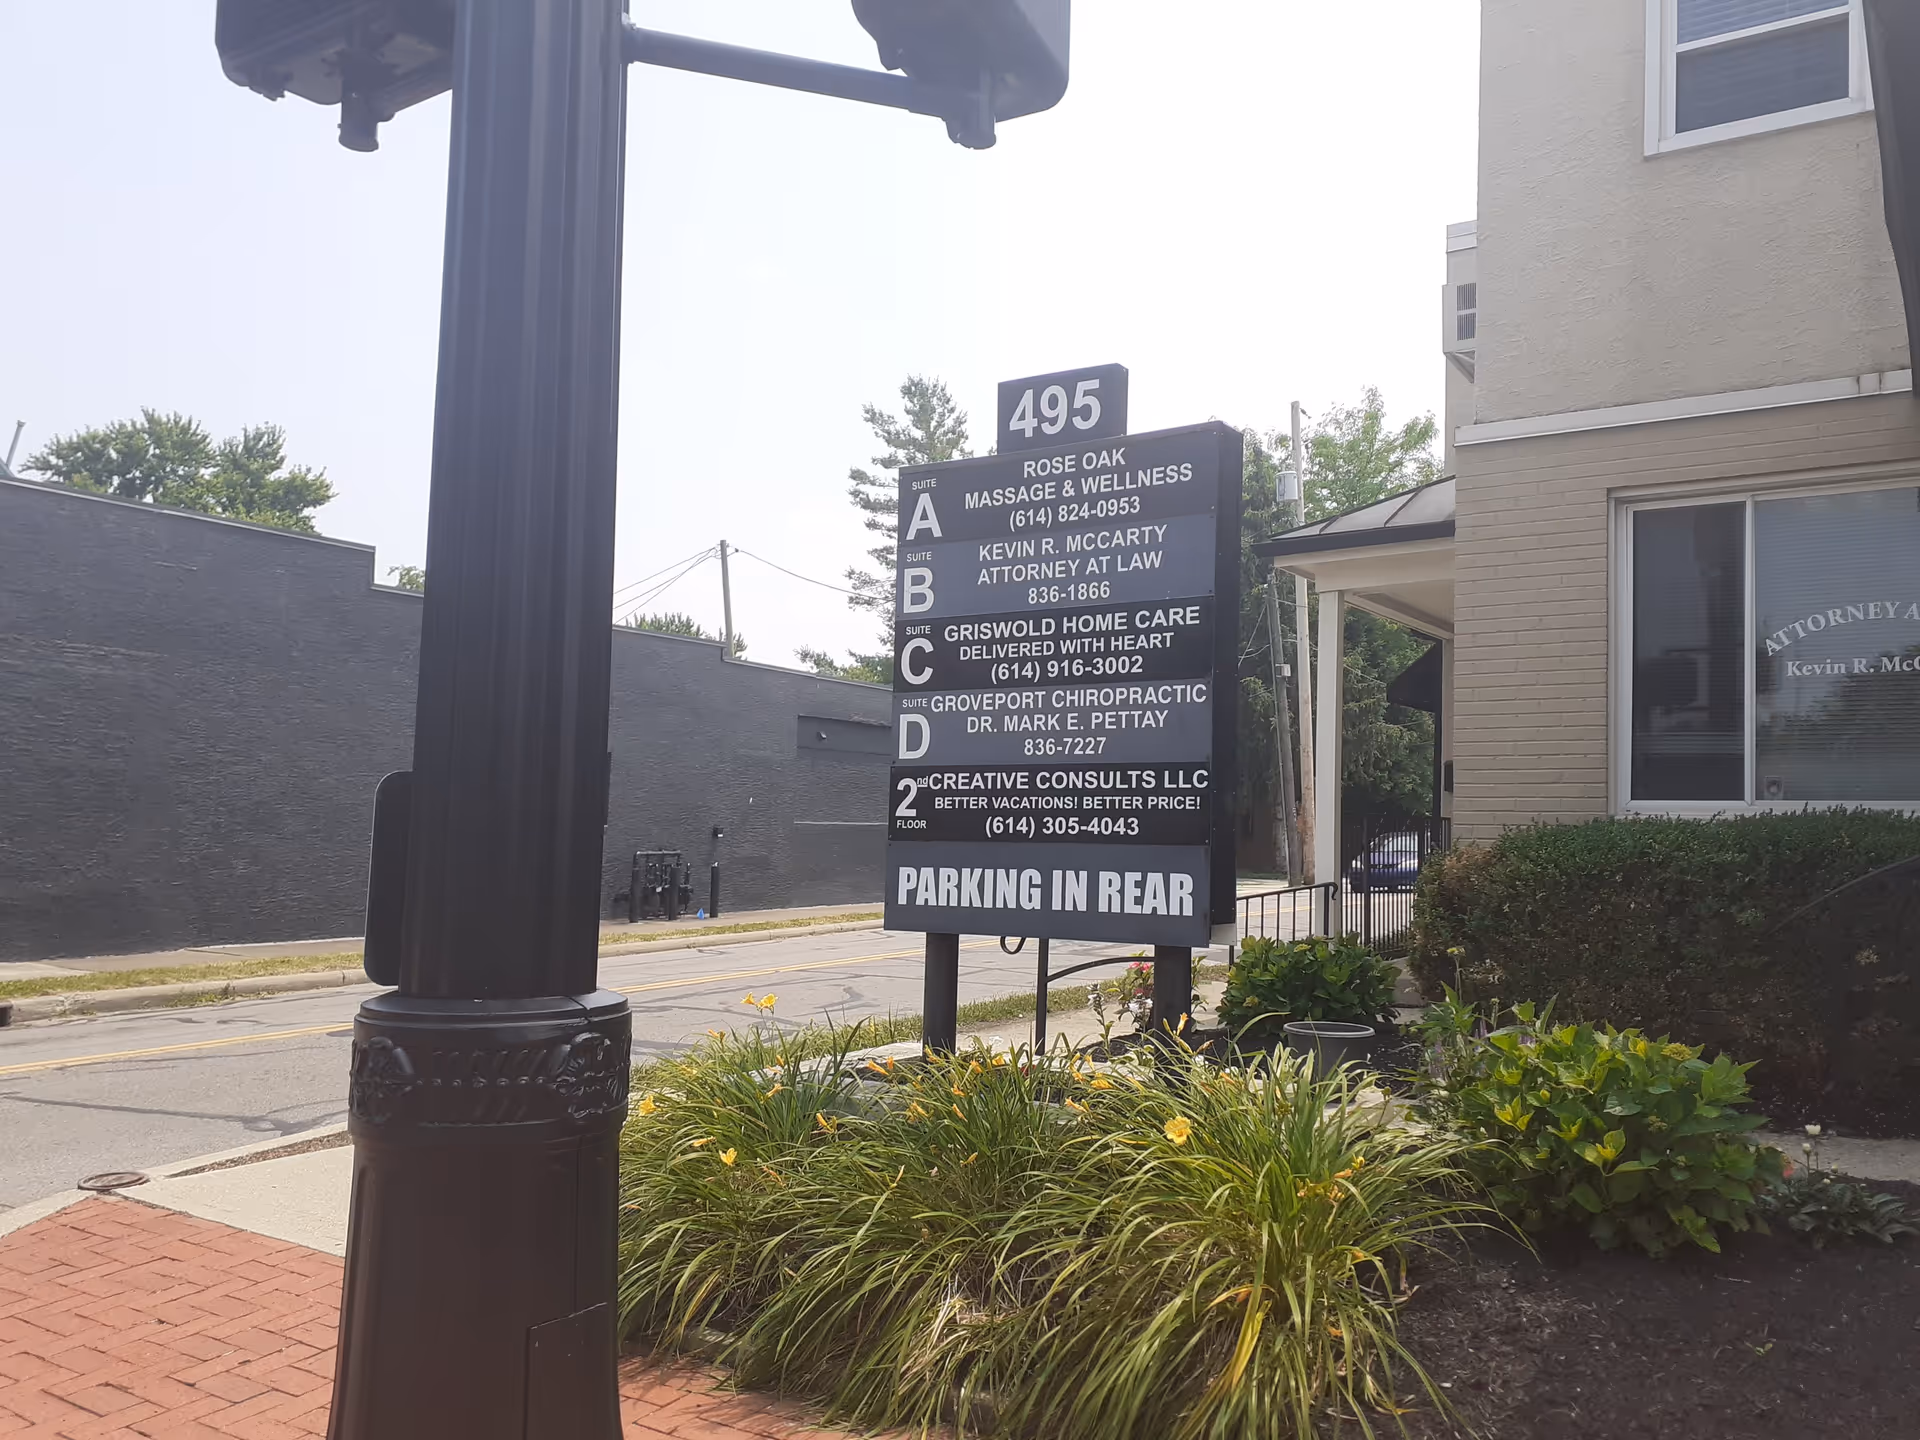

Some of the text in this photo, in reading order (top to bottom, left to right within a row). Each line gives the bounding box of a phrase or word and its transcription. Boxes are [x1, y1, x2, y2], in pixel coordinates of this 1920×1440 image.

[1009, 379, 1101, 438] 495
[1024, 448, 1126, 478] ROSE OAK
[912, 478, 937, 490] SUITE
[965, 463, 1192, 509] MASSAGE & WELLNESS
[906, 492, 942, 540] A
[1009, 497, 1140, 532] (614) 824-0953
[979, 524, 1168, 561] KEVIN R. MCCARTY
[906, 552, 932, 562] SUITE
[977, 551, 1163, 585] ATTORNEY AT LAW
[903, 567, 934, 613] B
[1028, 581, 1110, 604] 836-1866
[906, 625, 931, 635] SUITE
[944, 606, 1200, 642] GRISWOLD HOME CARE
[1764, 601, 1900, 656] ATTORNEY
[960, 632, 1174, 660] DELIVERED WITH HEART
[901, 638, 933, 684] C
[991, 656, 1143, 684] (614) 916-3002
[1787, 659, 1846, 676] Kevin
[1852, 658, 1874, 673] R.
[902, 698, 928, 708] SUITE
[931, 684, 1207, 712] GROVEPORT CHIROPRACTIC
[967, 710, 1169, 733] DR. MARK E. PETTAY
[898, 714, 930, 759] D
[1024, 738, 1107, 755] 836-7227
[929, 770, 1208, 790] CREATIVE CONSULTS LLC
[934, 796, 1200, 810] BETTER VACATIONS! BETTER PRICE!
[897, 819, 927, 829] FLOOR
[985, 817, 1139, 838] (614) 305-4043
[898, 867, 1193, 916] PARKING IN REAR
